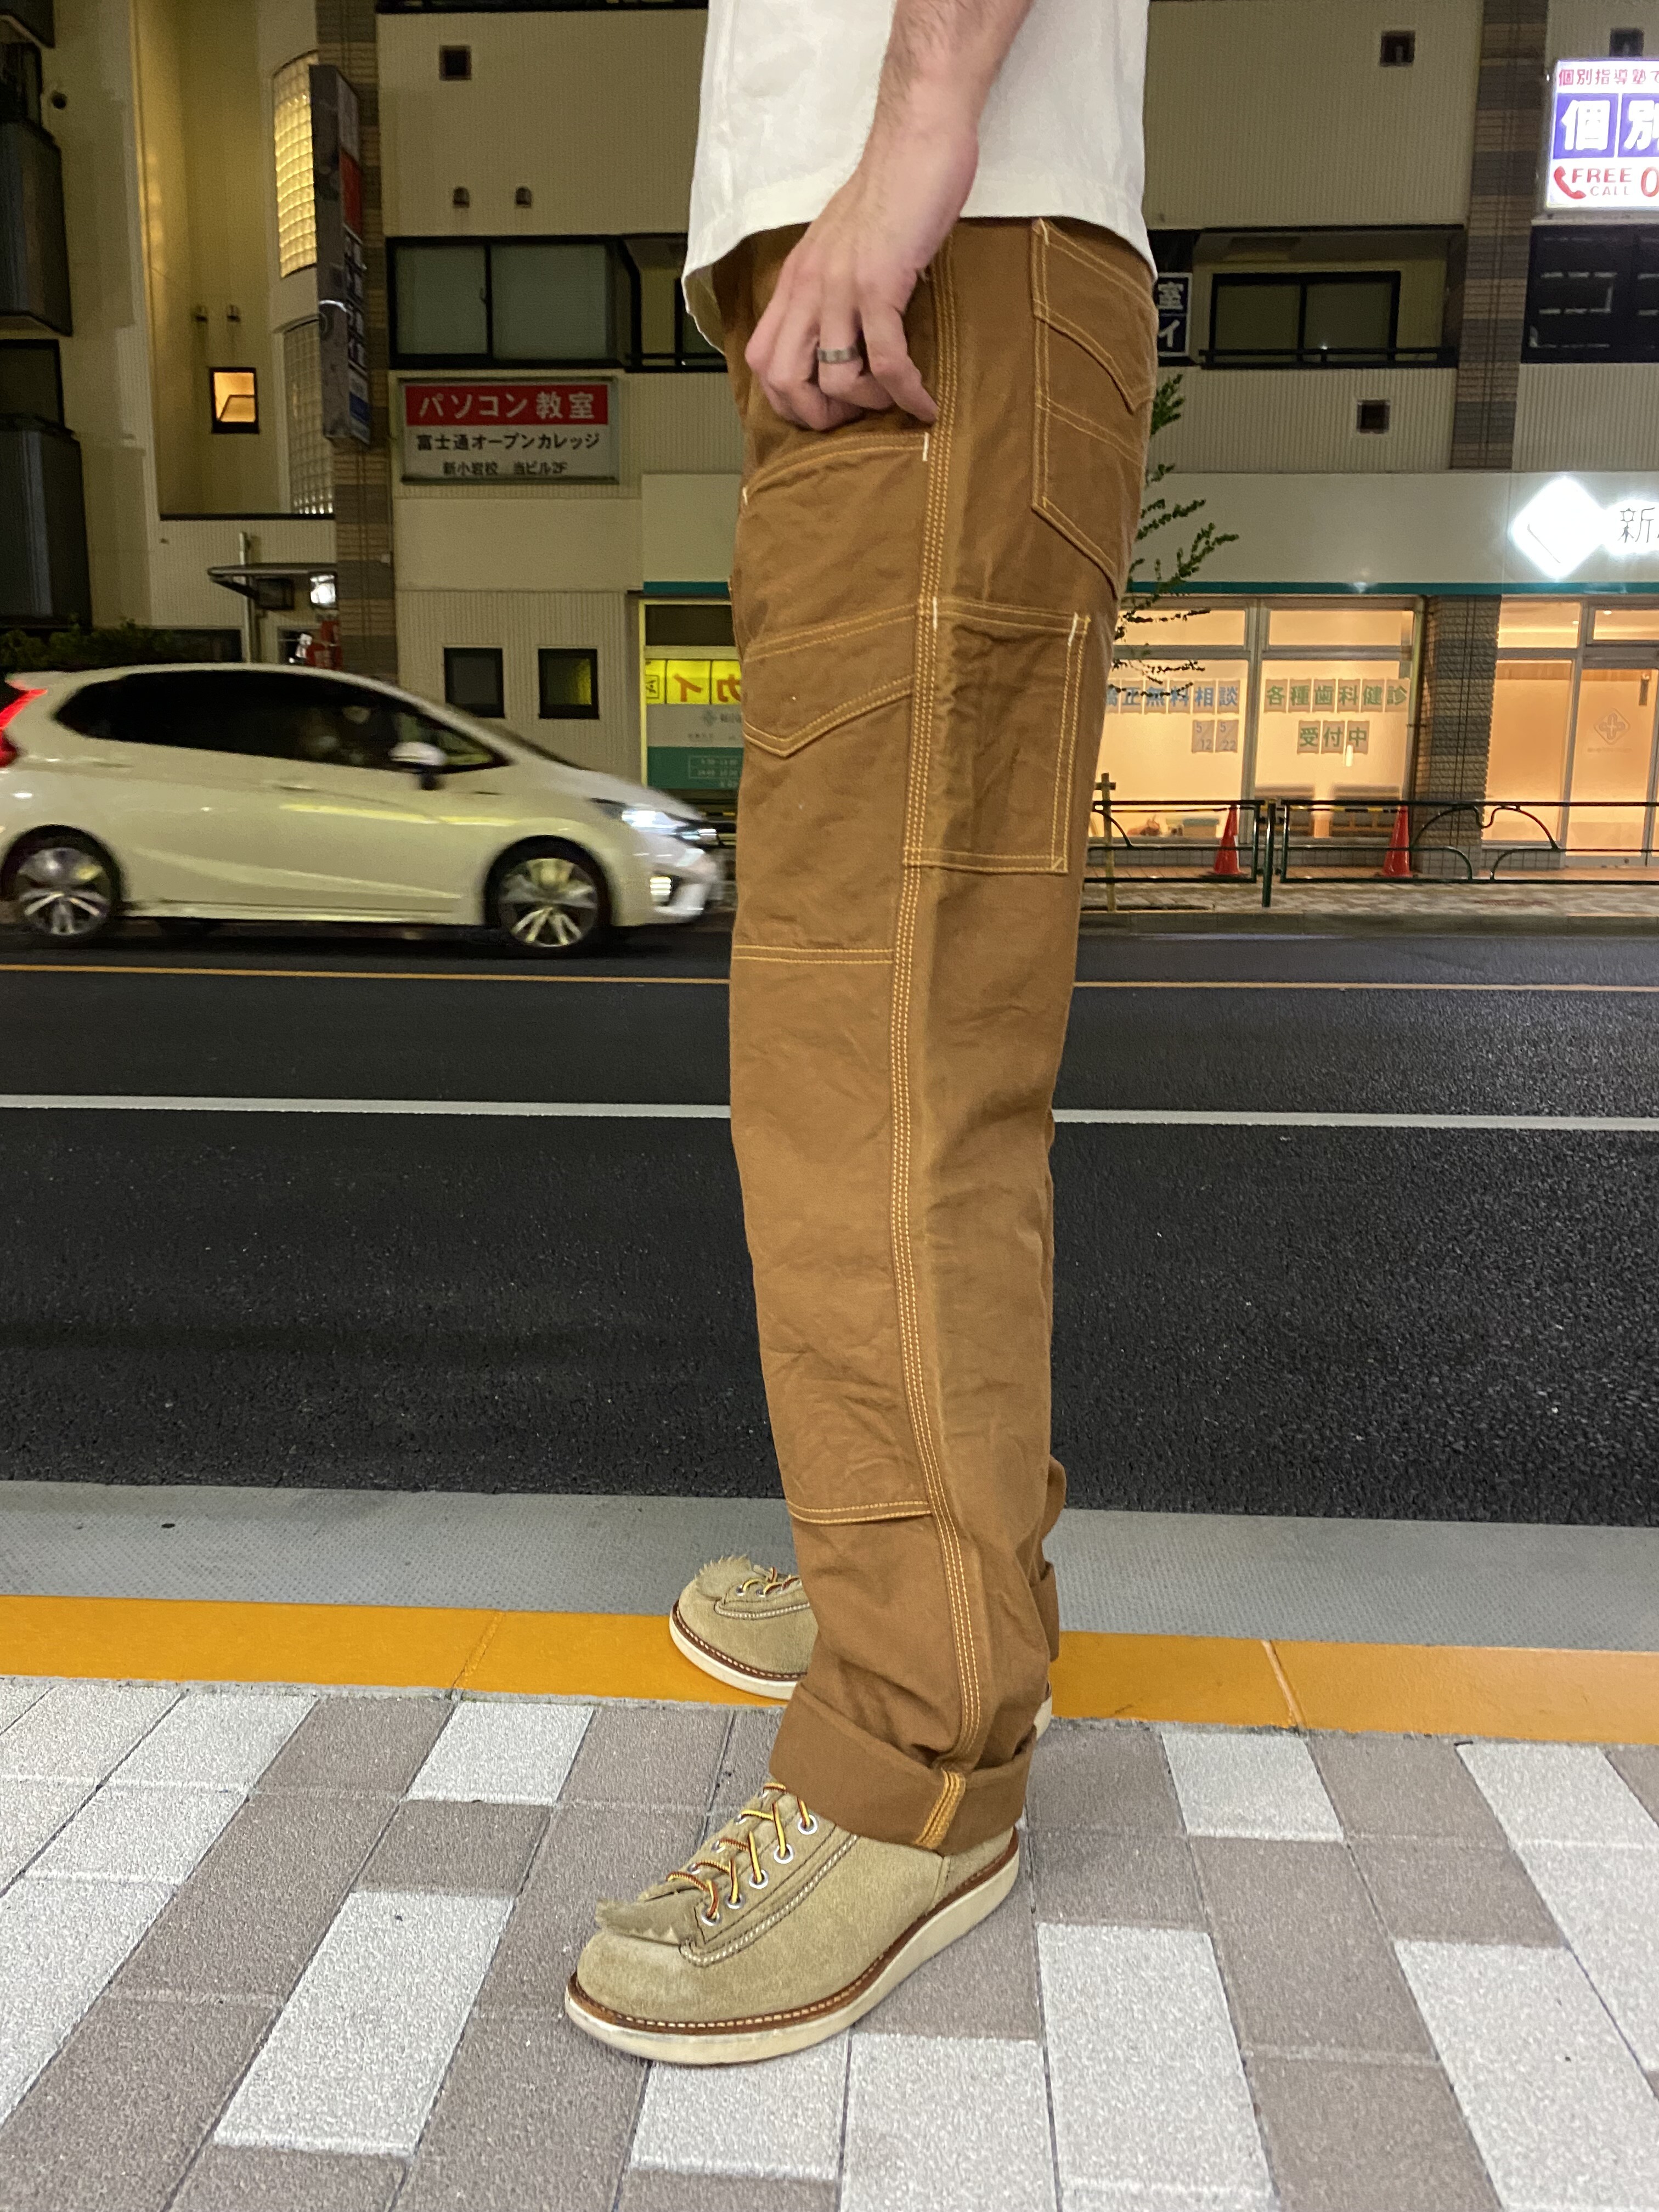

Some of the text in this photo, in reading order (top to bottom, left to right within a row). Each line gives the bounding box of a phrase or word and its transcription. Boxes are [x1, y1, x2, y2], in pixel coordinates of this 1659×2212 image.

[1571, 167, 1633, 183] FREE
[1590, 186, 1630, 196] CALL
[419, 391, 594, 419] パソコン教室
[417, 432, 600, 451] 富士通オープンカレッジ
[1618, 507, 1659, 543] 新
[1267, 685, 1408, 706] 各種歯科健診
[1299, 726, 1367, 747] 受付中
